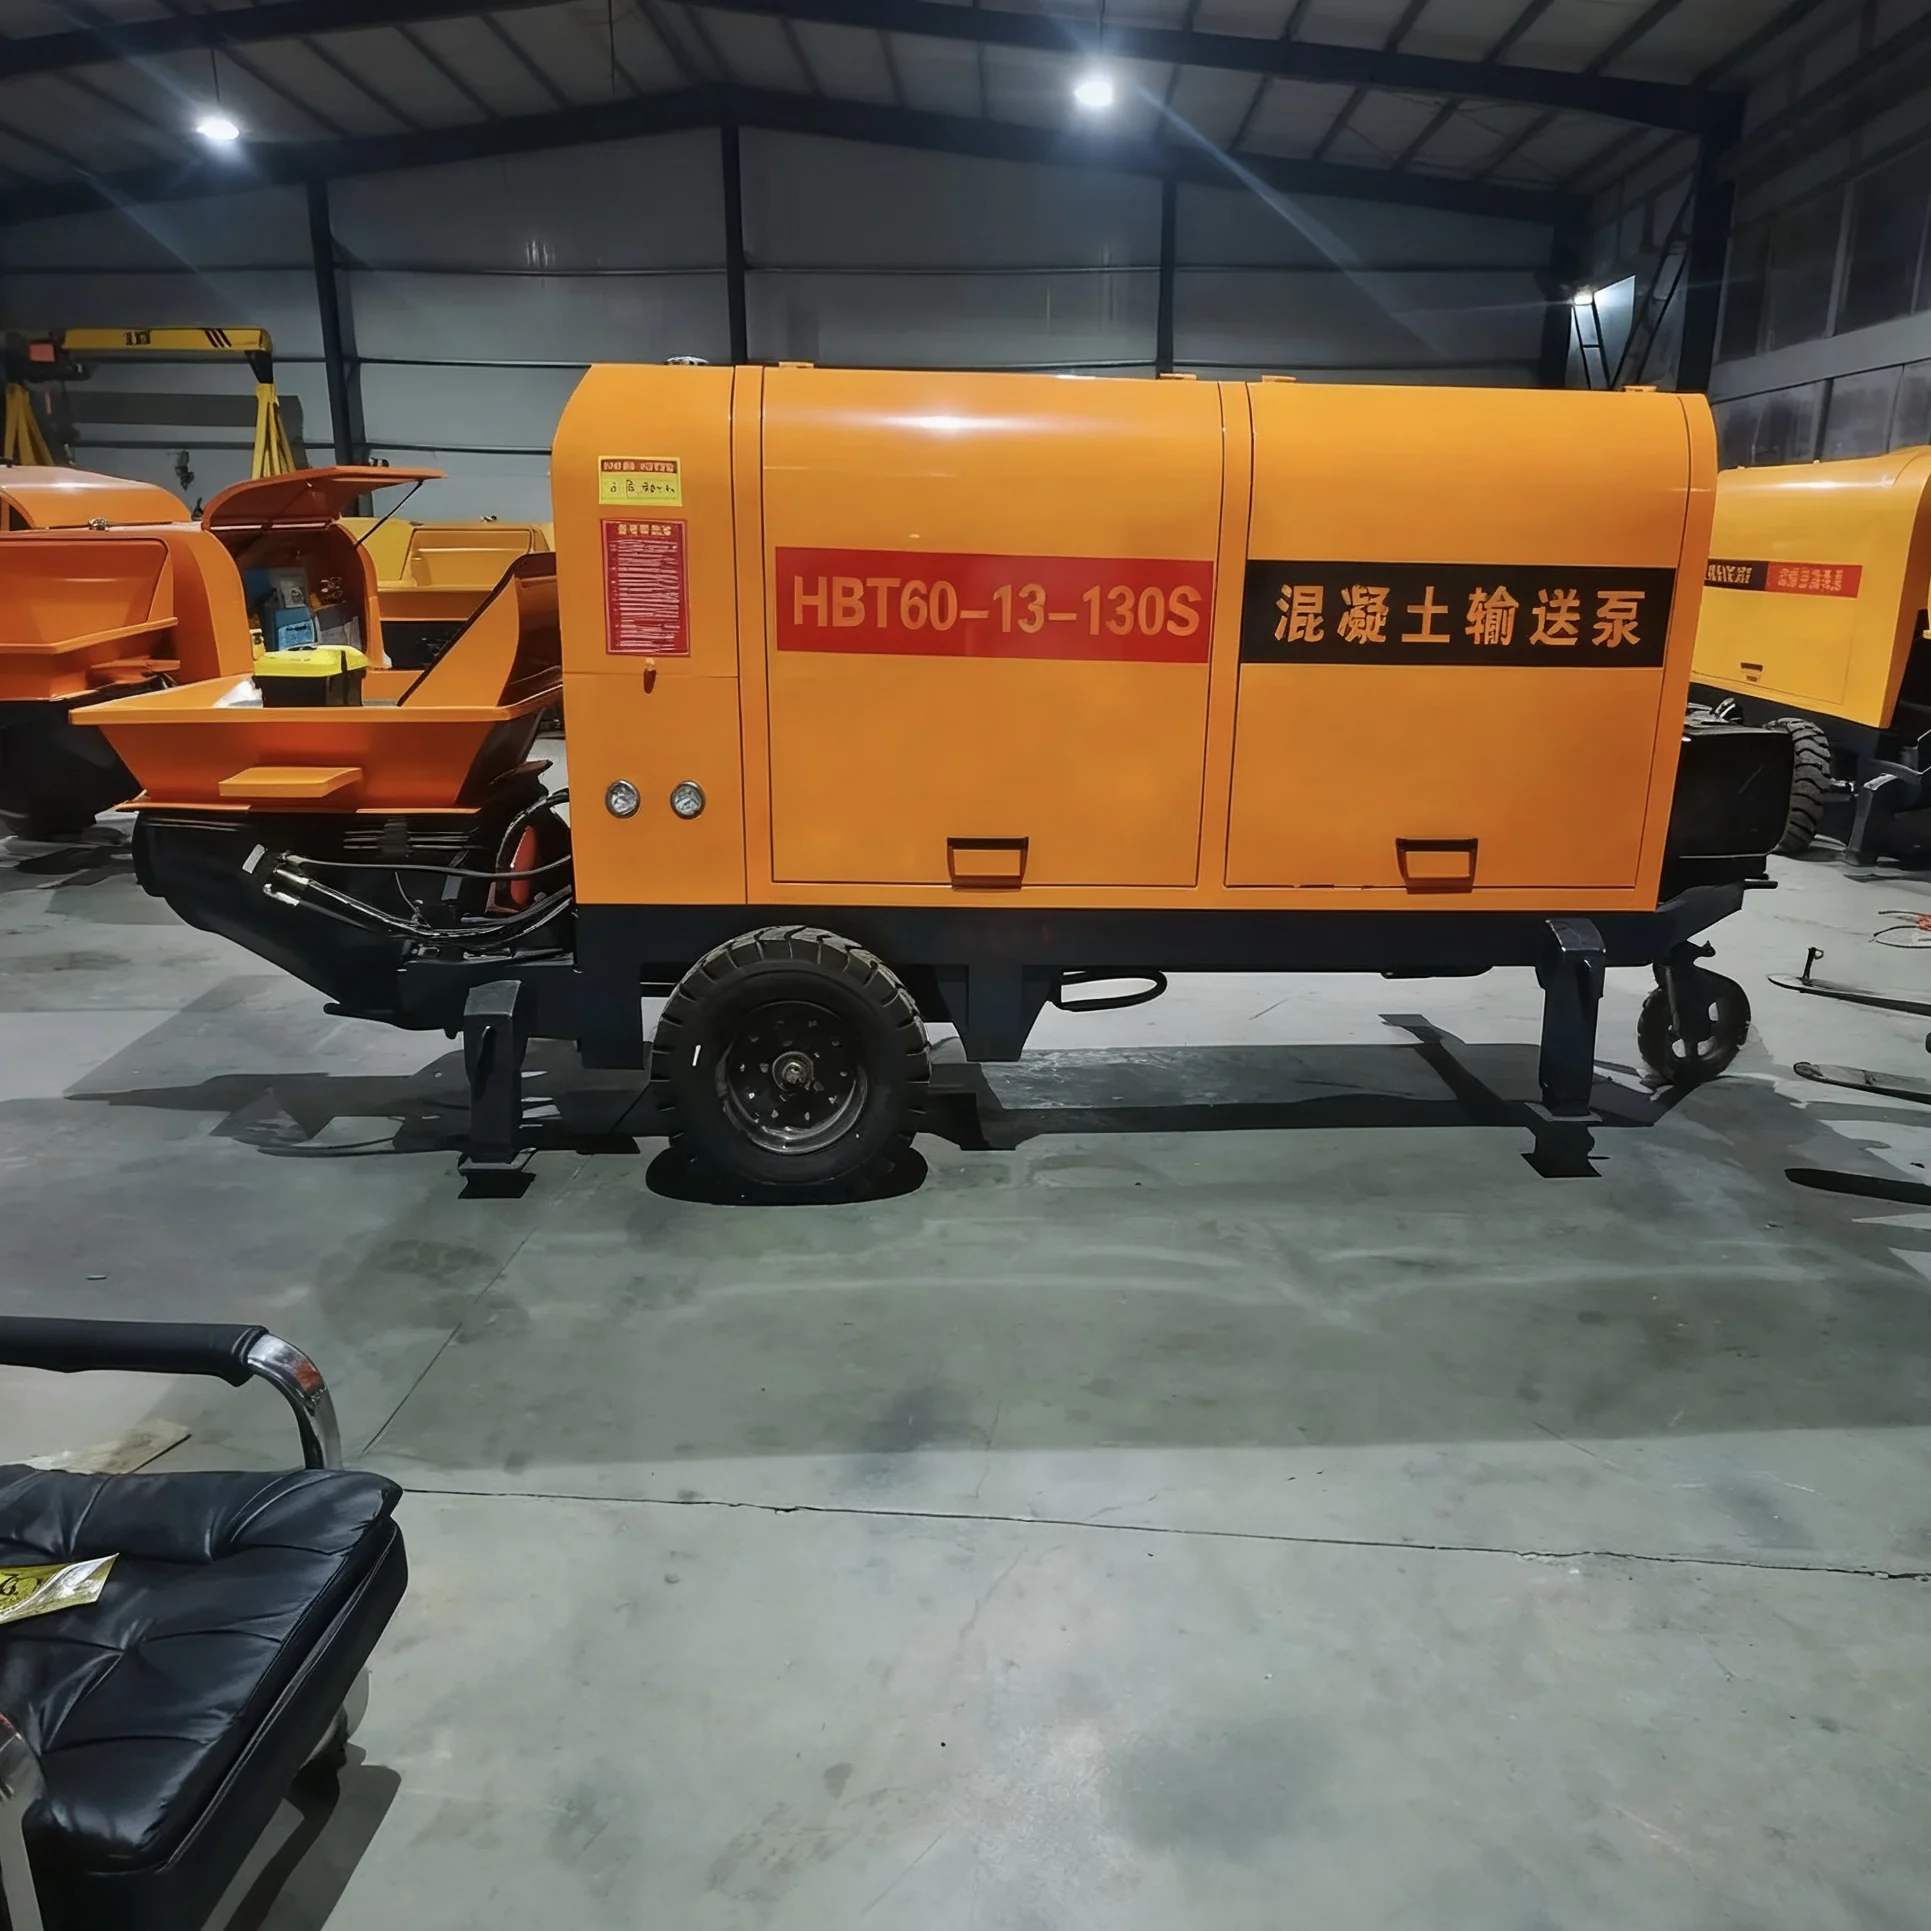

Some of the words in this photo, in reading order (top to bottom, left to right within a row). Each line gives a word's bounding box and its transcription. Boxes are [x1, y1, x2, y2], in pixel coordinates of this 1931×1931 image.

[793, 576, 1202, 636] HBT60-13-130S
[1274, 583, 1646, 648] 混凝土输送泵
